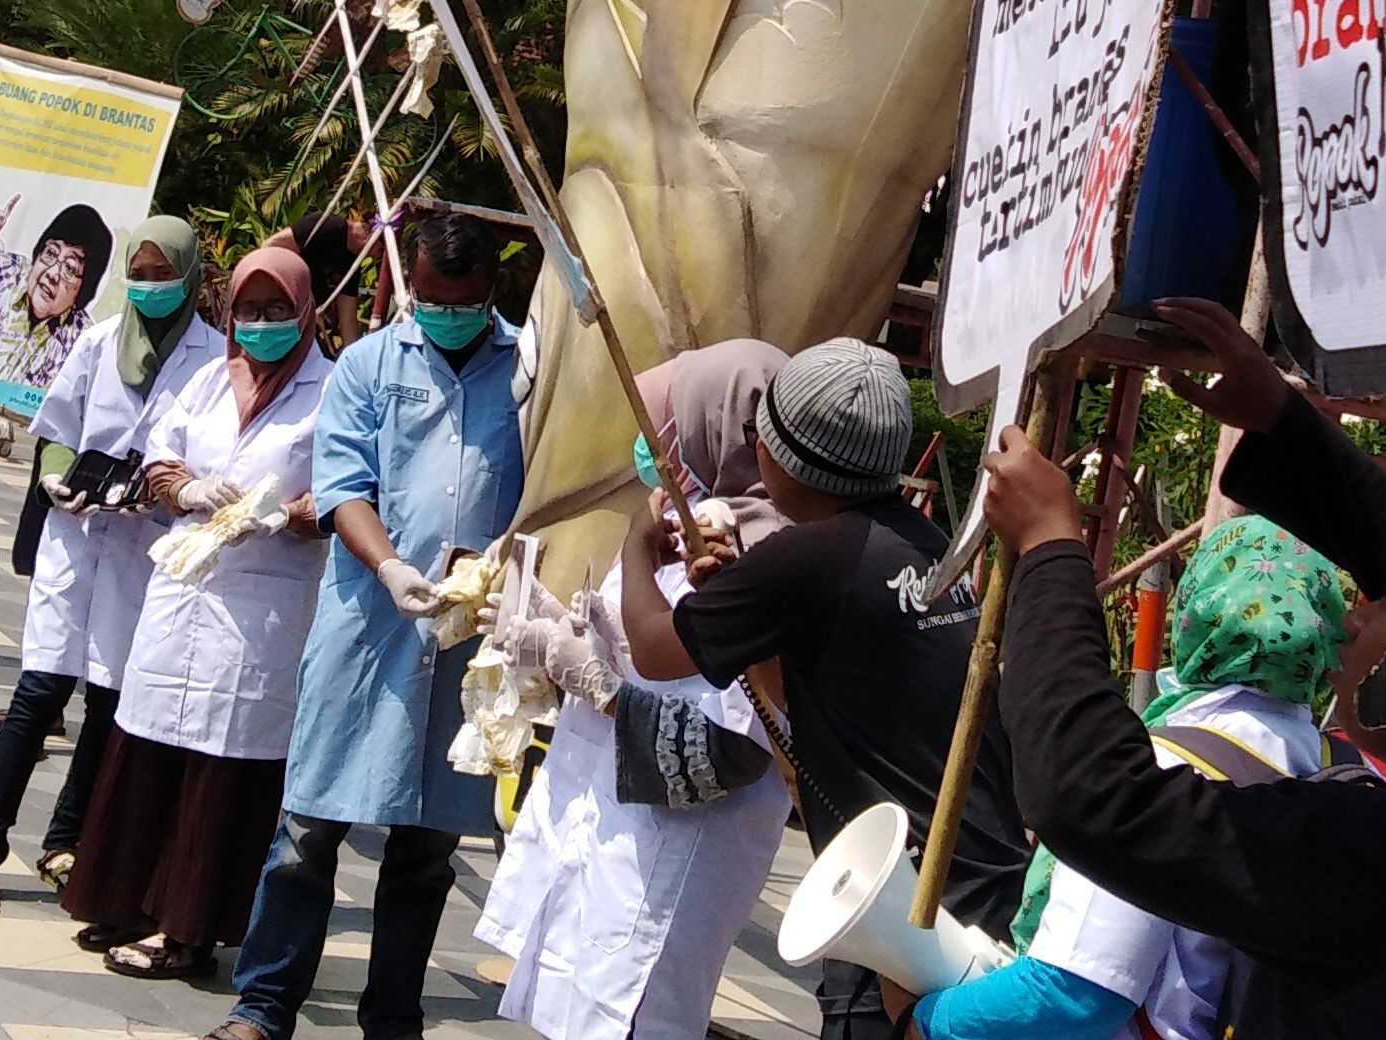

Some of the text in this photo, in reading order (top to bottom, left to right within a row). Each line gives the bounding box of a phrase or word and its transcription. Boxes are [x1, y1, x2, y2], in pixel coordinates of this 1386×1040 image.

[39, 92, 82, 115] POPOK
[84, 102, 96, 118] DI
[99, 106, 156, 133] BRANTAS
[916, 613, 953, 631] SUNGAI
